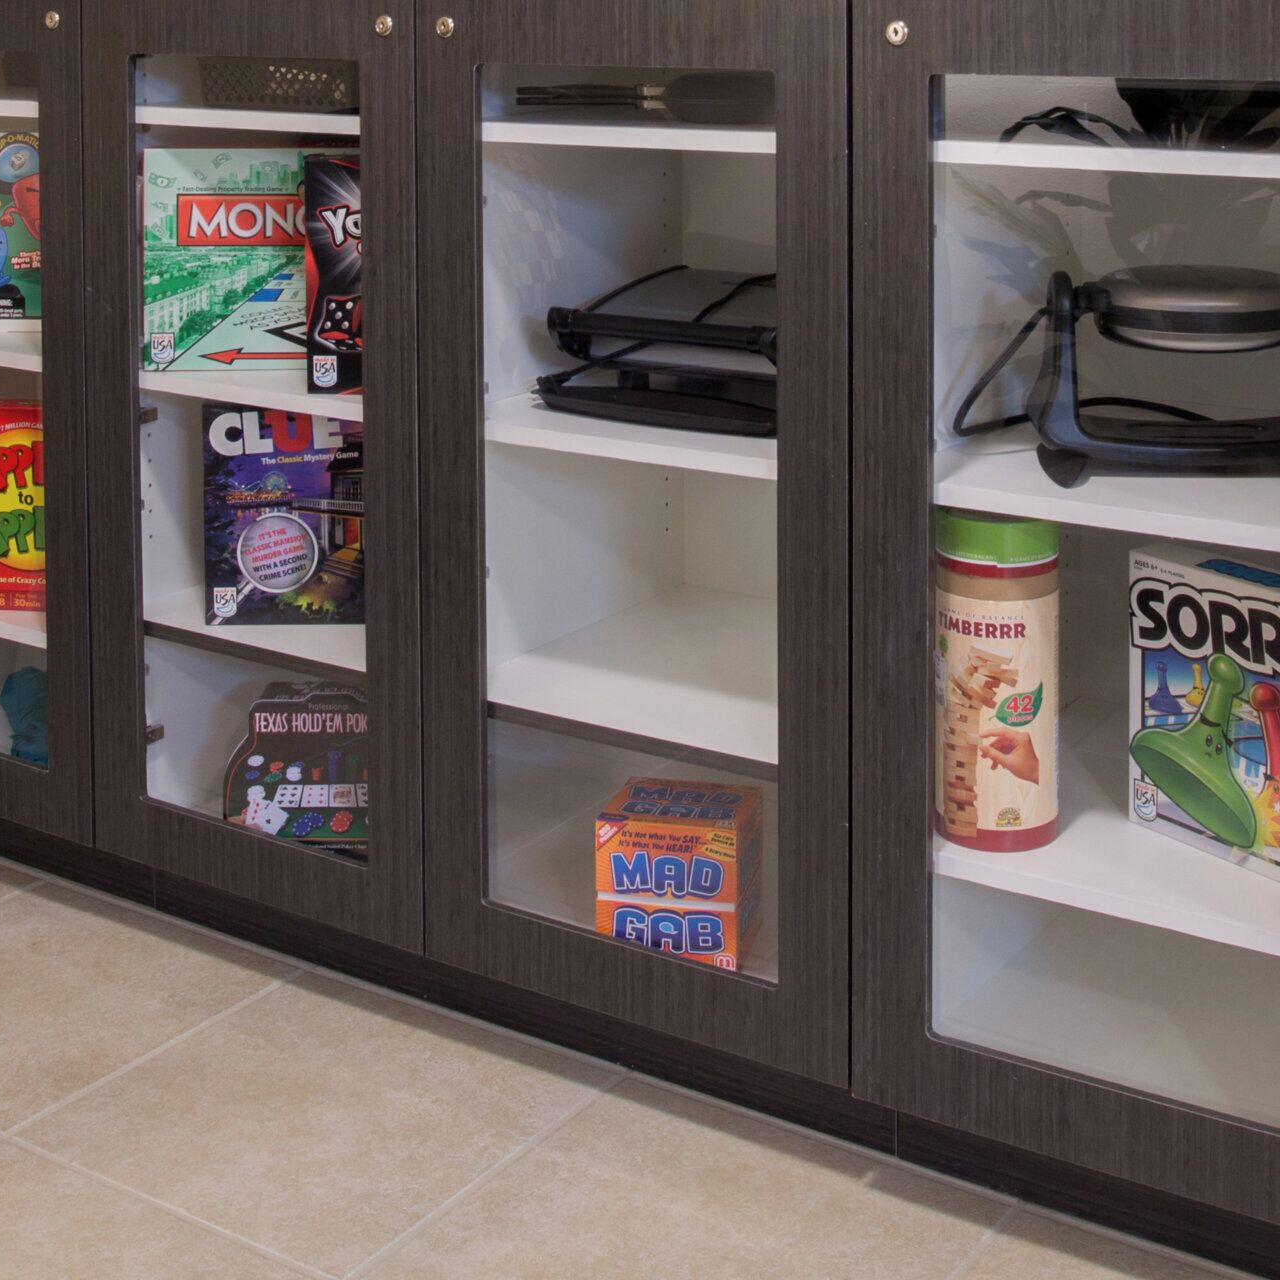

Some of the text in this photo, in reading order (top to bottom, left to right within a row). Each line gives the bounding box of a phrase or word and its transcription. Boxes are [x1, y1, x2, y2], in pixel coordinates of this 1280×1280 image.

[218, 185, 243, 193] Property
[244, 185, 266, 193] Trading
[152, 339, 173, 352] USA
[315, 362, 336, 375] USA
[208, 410, 344, 457] CLUE
[261, 451, 359, 465] The Classic Mystery Game
[18, 491, 34, 505] to
[272, 527, 287, 537] THE
[251, 544, 305, 564] MURDER GAME
[253, 563, 272, 573] WITH
[279, 553, 308, 567] SECOND
[1134, 559, 1150, 569] AGES
[258, 563, 307, 582] CRIME SCENE!
[16, 577, 37, 585] Crazy
[14, 598, 40, 608] 30min
[215, 593, 236, 606] USA
[1005, 694, 1034, 713] 42
[254, 712, 288, 733] TEXAS
[291, 712, 343, 733] HOLD'EM
[630, 784, 744, 804] MAD
[1136, 787, 1156, 806] USA
[621, 830, 633, 838] It's
[648, 833, 666, 841] What
[619, 839, 694, 854] It's What You HEAR!
[610, 850, 724, 897] MAD
[612, 906, 725, 954] GAB
